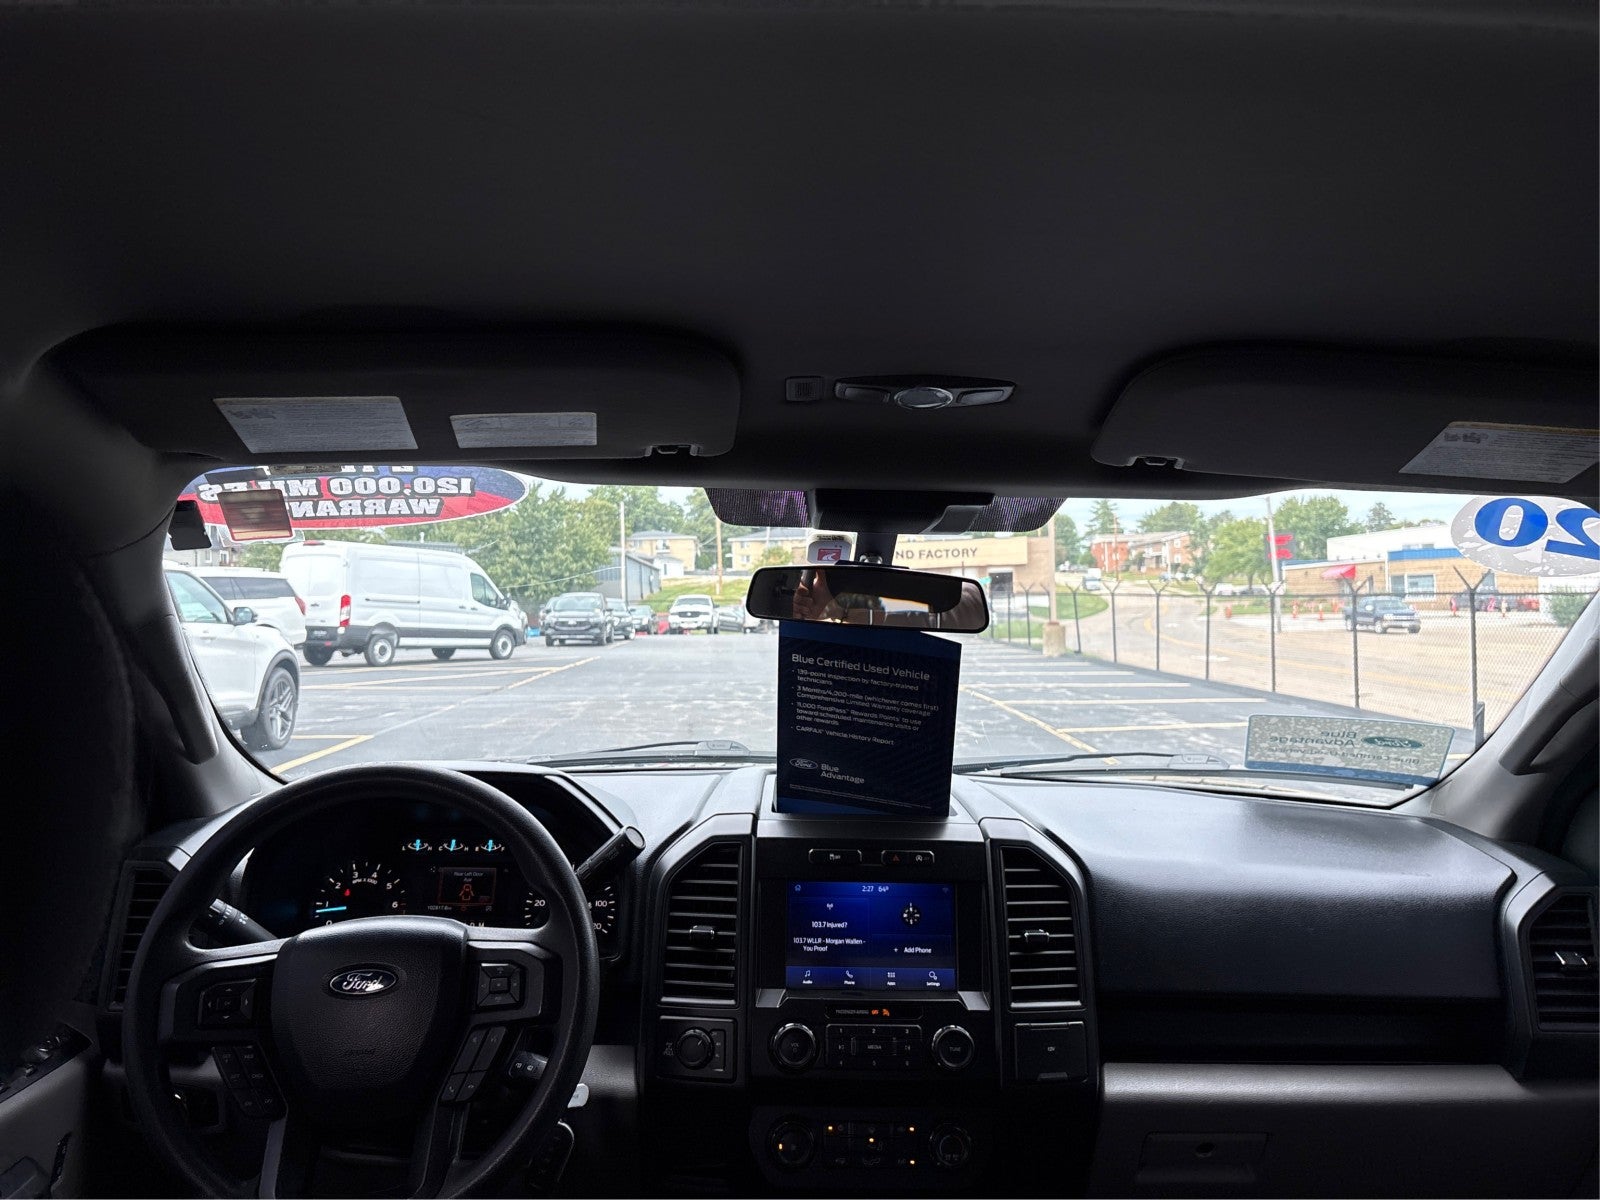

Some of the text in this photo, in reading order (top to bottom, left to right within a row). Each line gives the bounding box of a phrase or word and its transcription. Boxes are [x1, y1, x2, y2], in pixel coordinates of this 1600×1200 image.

[918, 547, 978, 559] FACTORY
[791, 653, 931, 681] Blue Certified Used Vehicle
[797, 675, 833, 685] technicians
[820, 763, 840, 773] Blue
[820, 770, 865, 784] Advantage
[534, 899, 546, 907] 20
[826, 921, 848, 929] Injured?
[825, 937, 845, 945] Morgan
[341, 971, 386, 992] Ford
